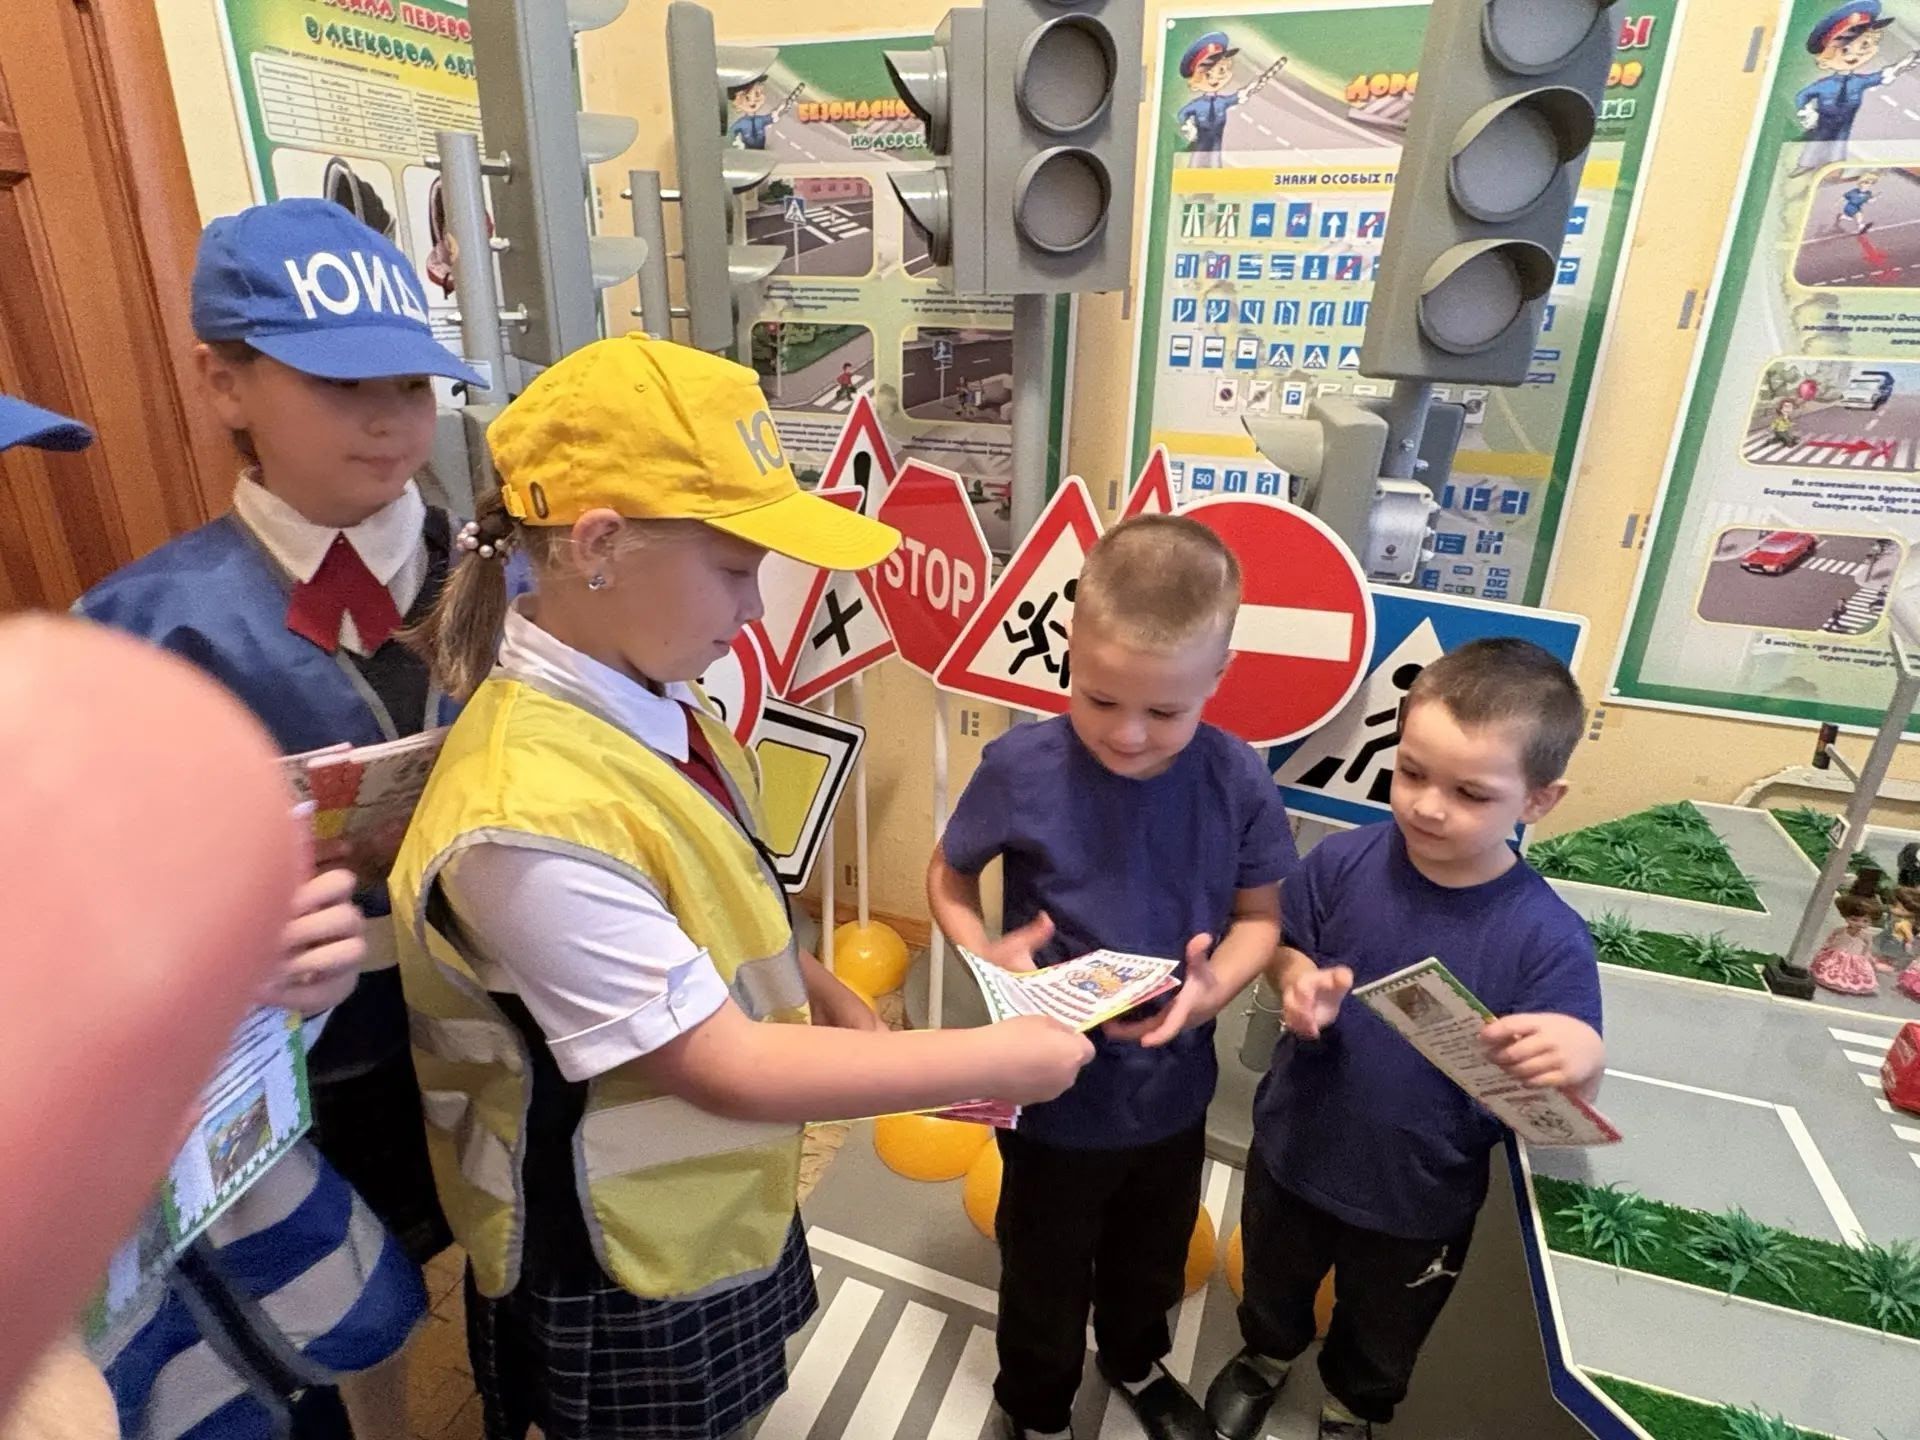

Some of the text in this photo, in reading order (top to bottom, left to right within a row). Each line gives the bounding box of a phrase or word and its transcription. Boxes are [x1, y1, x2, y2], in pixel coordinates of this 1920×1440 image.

[400, 2, 472, 42] ПЕРЕВО
[305, 13, 322, 43] В
[325, 20, 438, 70] ЛЕГКОВОМ
[443, 53, 478, 79] АВТ
[797, 99, 912, 123] БЕЗОПАСНО
[873, 131, 926, 151] ДОРОГ
[1274, 174, 1317, 185] ЗНАКИ
[1321, 173, 1381, 185] ОСОБЫХ
[284, 251, 429, 324] ЮИД
[735, 410, 784, 476] Ю
[1195, 473, 1212, 486] 50
[884, 537, 976, 620] STOP
